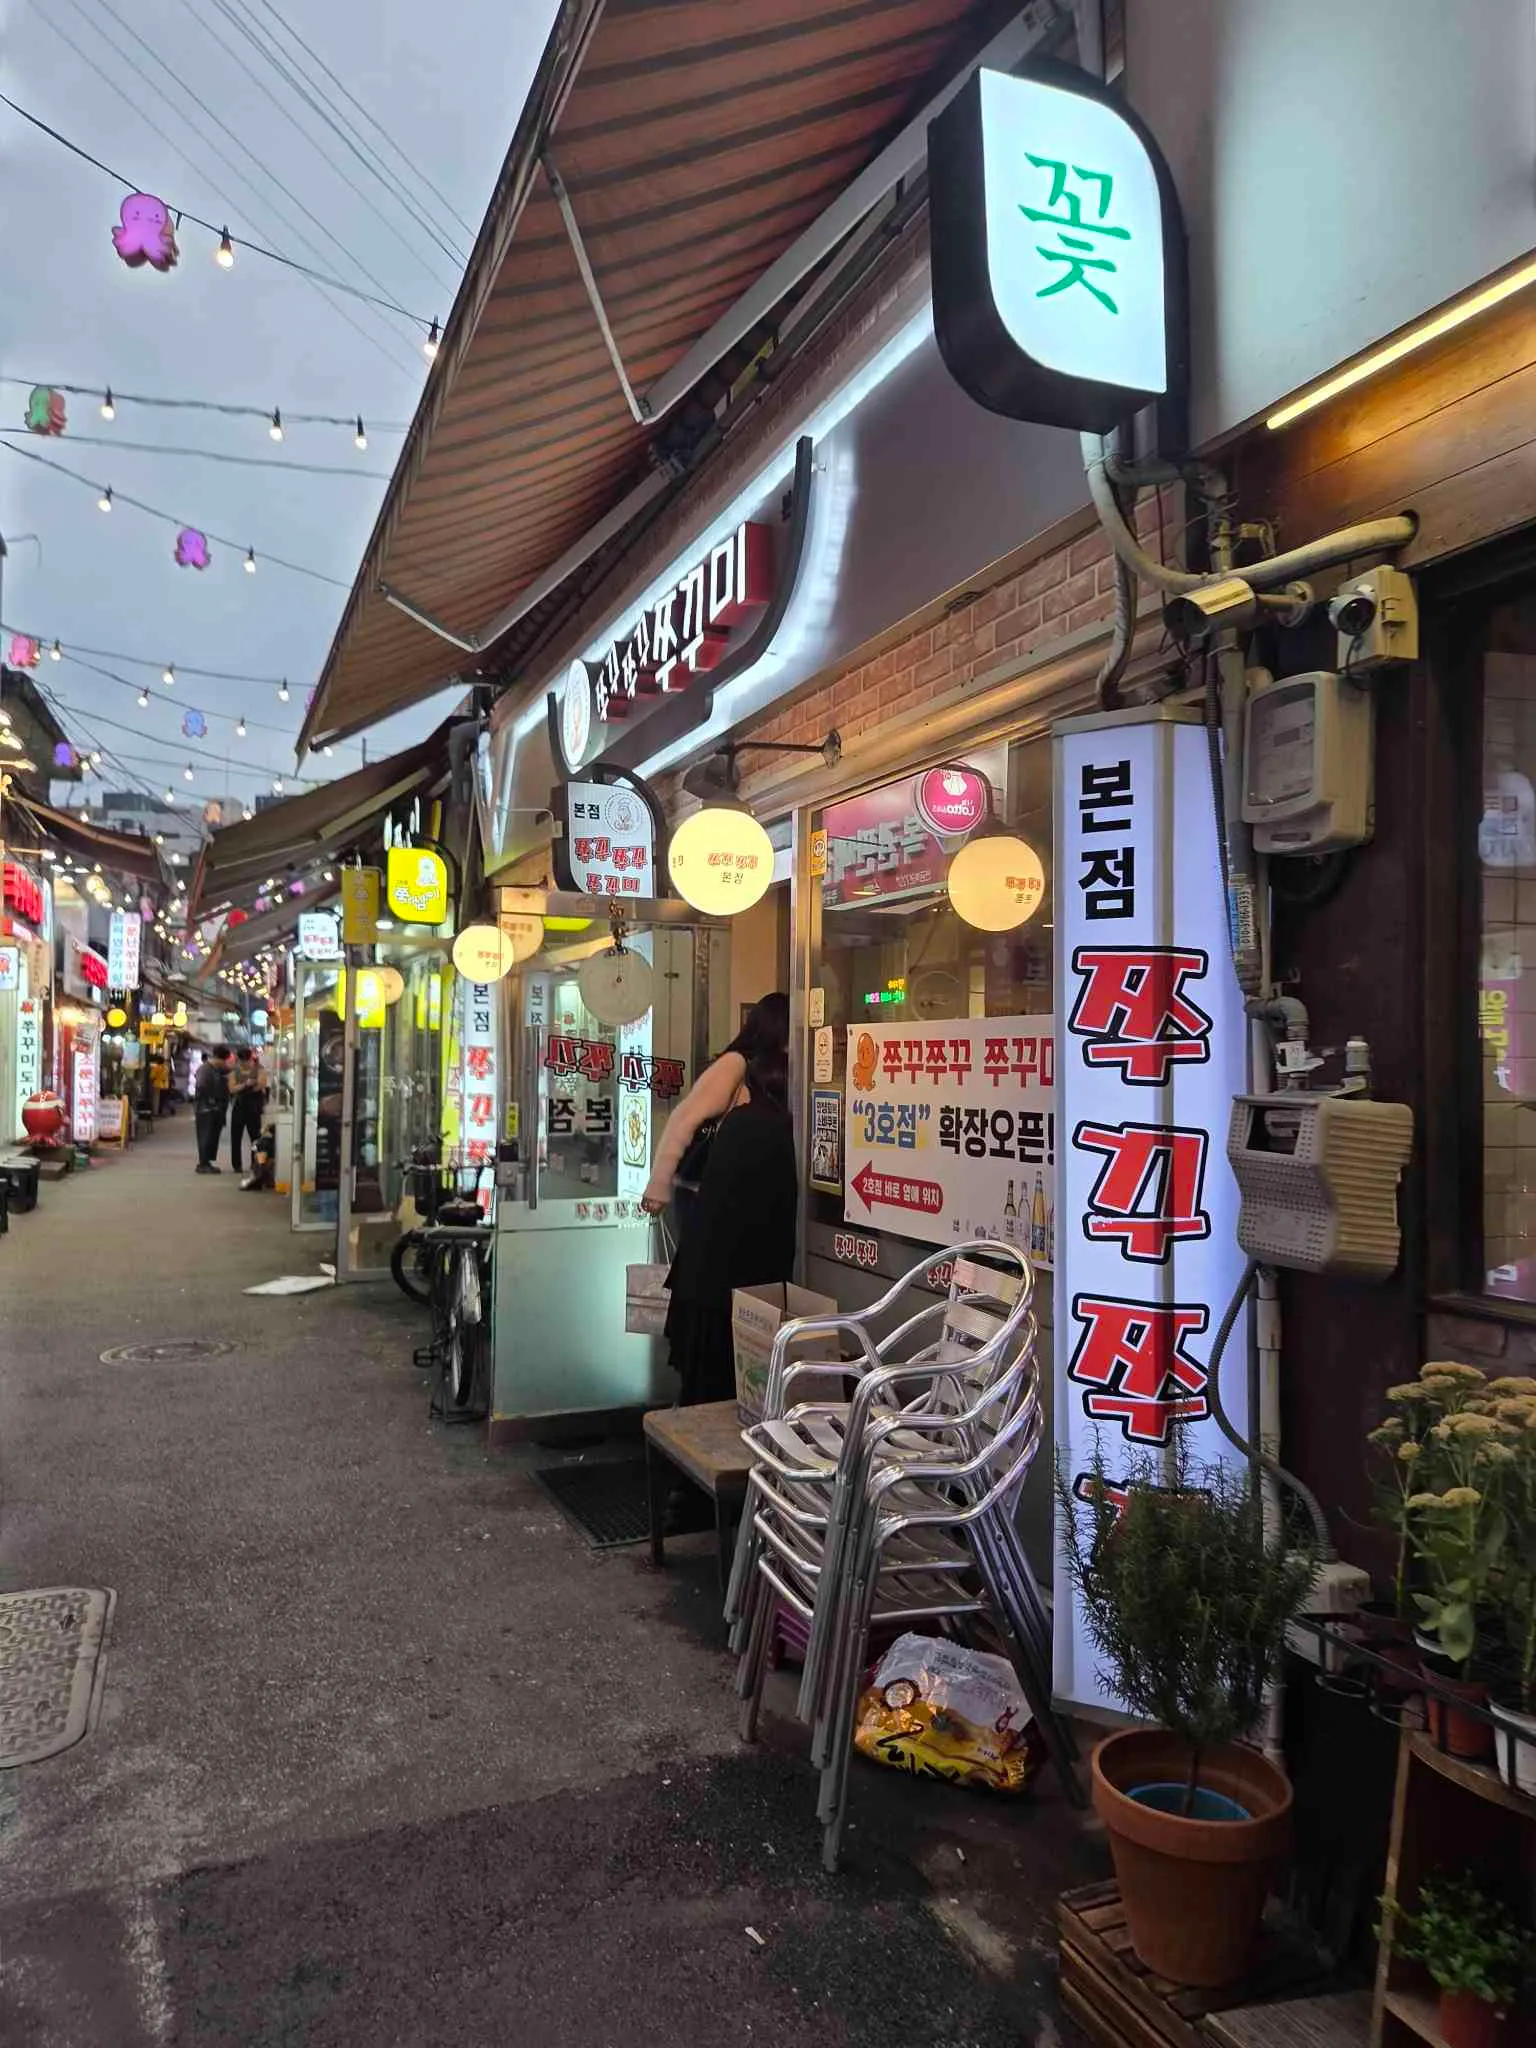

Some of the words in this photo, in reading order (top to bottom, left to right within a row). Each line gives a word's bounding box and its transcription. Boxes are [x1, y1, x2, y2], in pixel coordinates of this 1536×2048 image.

[1017, 152, 1132, 316] 꽃
[574, 802, 600, 819] 본점
[1078, 759, 1136, 921] 본점
[586, 872, 641, 895] 쭈꾸미
[473, 983, 490, 1033] 본점
[883, 1039, 972, 1086] 쭈꾸쭈꾸
[939, 1105, 1055, 1166] 확장오픈!
[862, 1177, 882, 1197] 2호점
[884, 1180, 900, 1200] 바로
[922, 1187, 940, 1208] 위치
[1067, 946, 1214, 1585] 쭈꾸쭈
